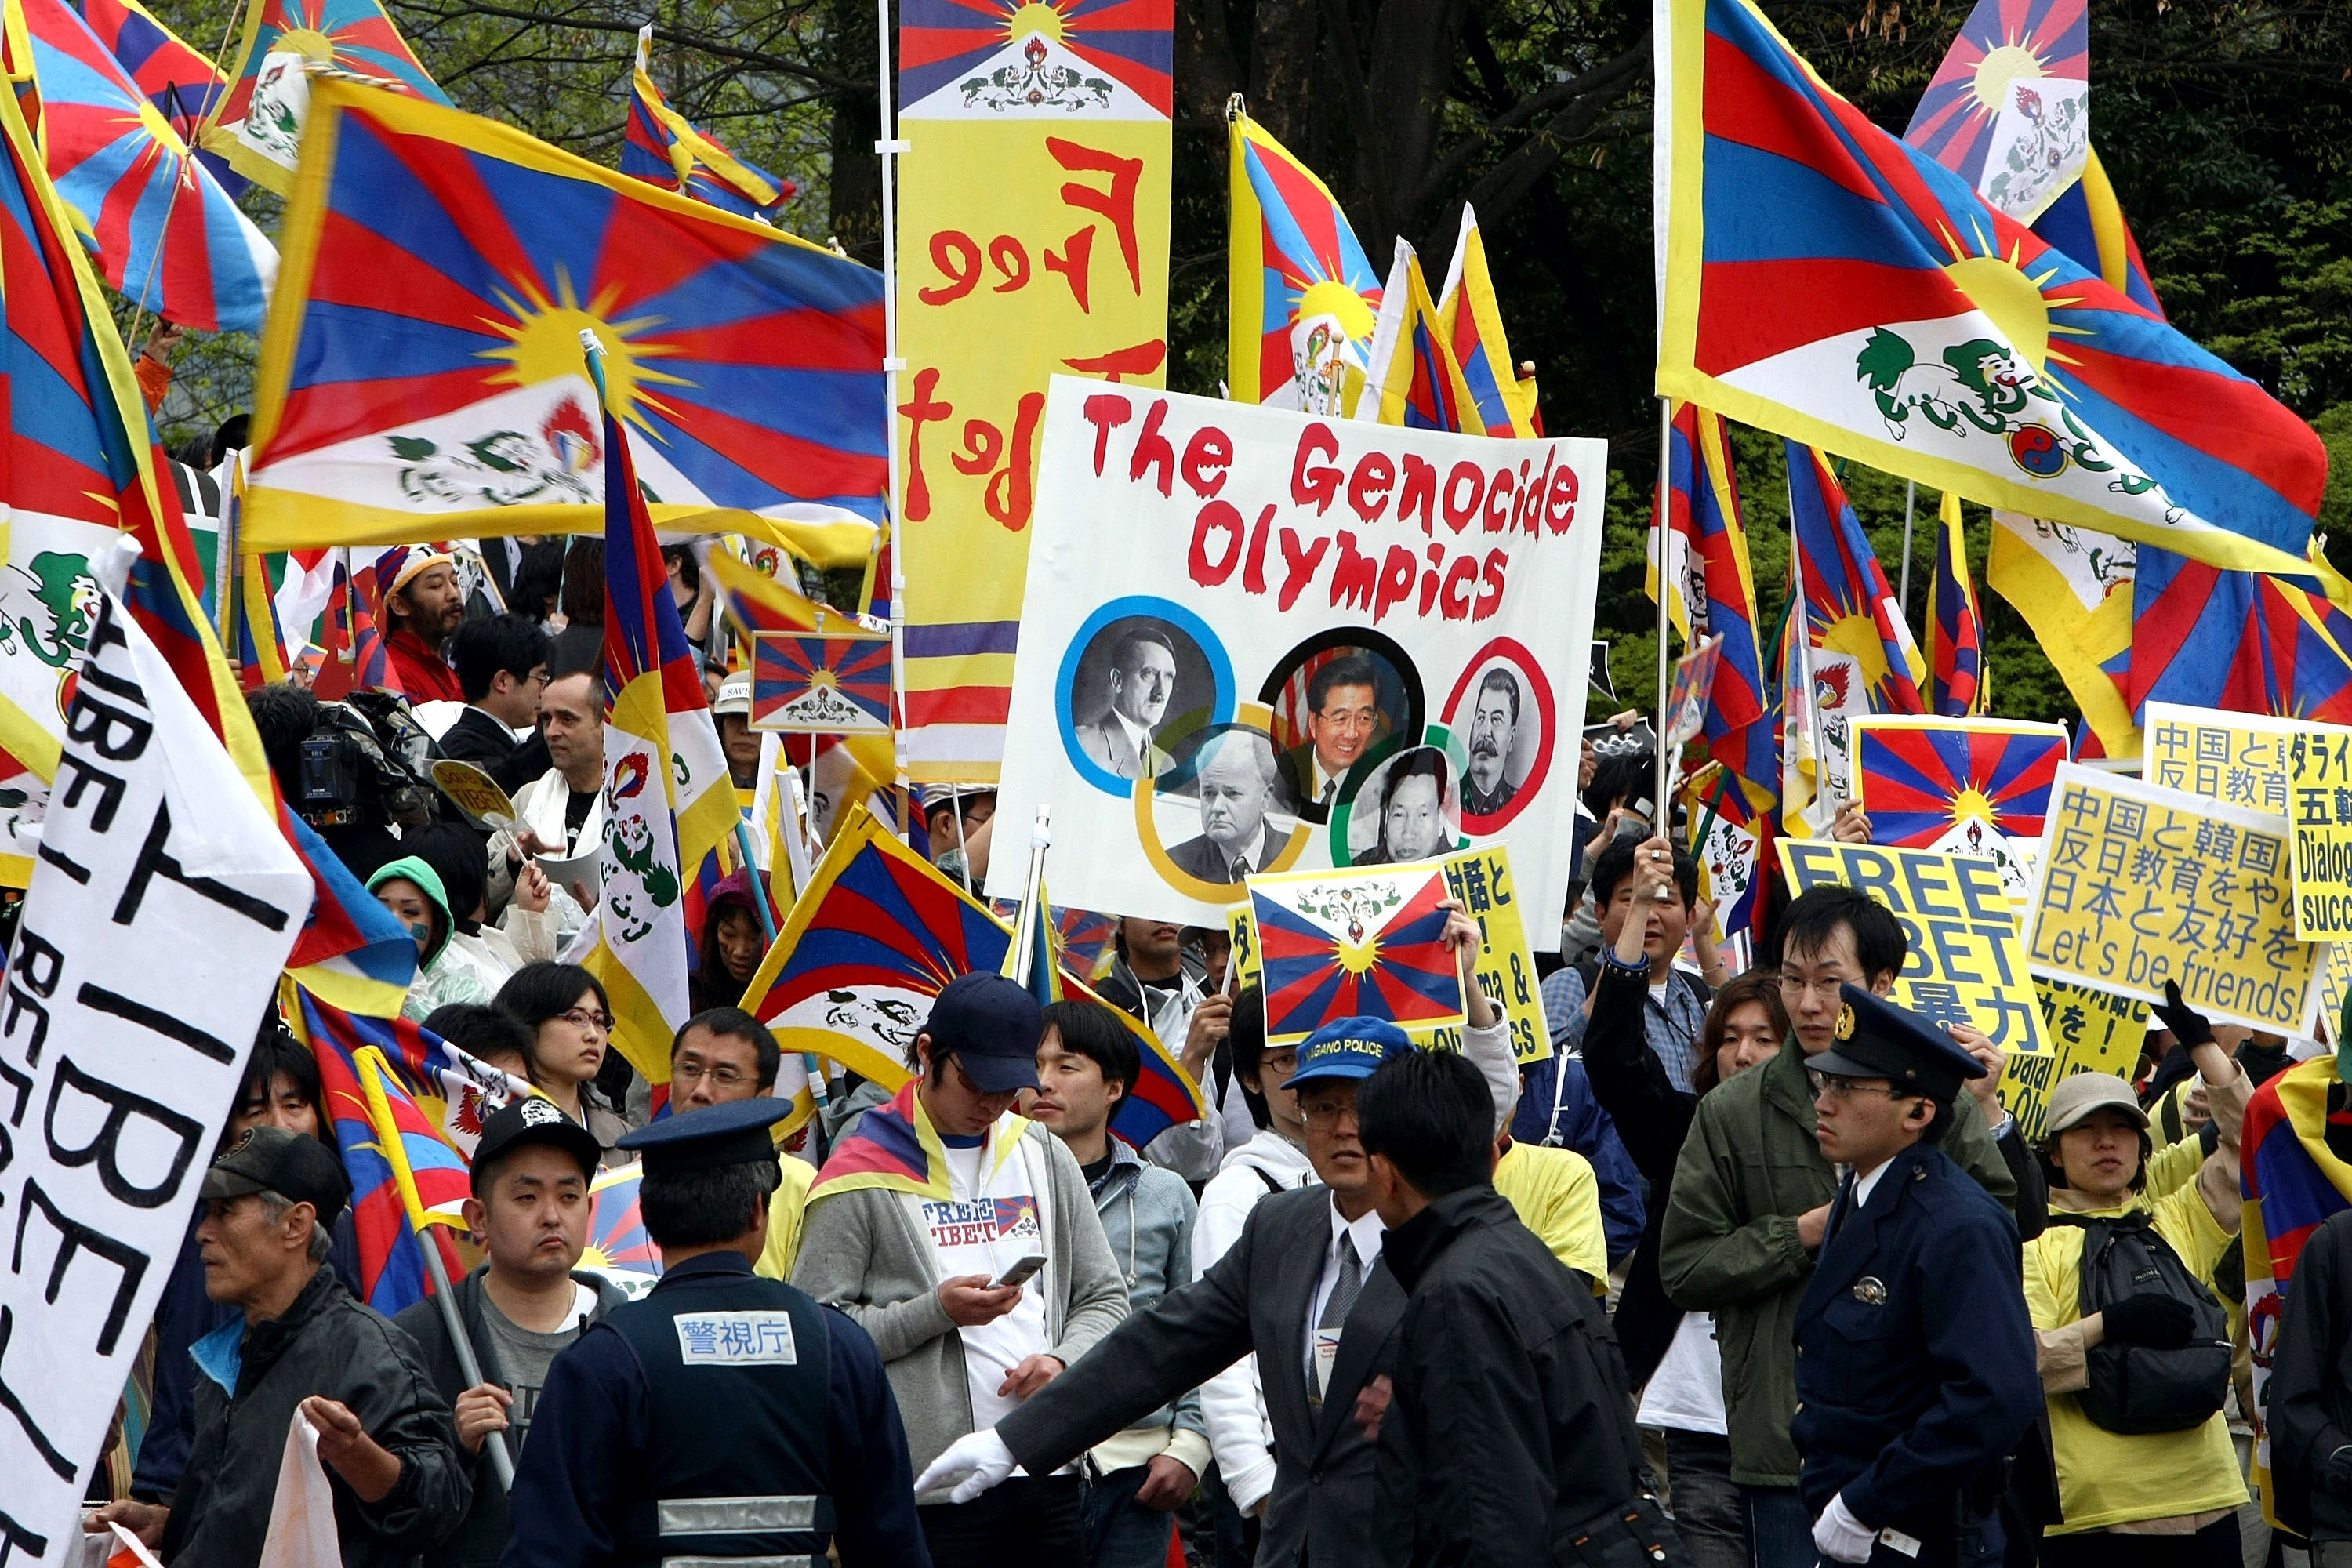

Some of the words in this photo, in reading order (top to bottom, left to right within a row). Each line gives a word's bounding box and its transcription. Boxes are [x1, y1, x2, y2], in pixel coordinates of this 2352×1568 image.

[1083, 394, 1233, 499] The
[1290, 423, 1578, 544] Genocide
[1187, 499, 1509, 625] Olympics
[2290, 733, 2350, 782] ダライ
[1787, 844, 2014, 923] FREE
[1509, 952, 1531, 1006] &
[1896, 917, 2014, 986] BET
[2031, 912, 2119, 977] Let's
[2125, 935, 2171, 989] be
[2180, 949, 2309, 1025] friends!
[1344, 1039, 1384, 1058] POLICE
[1889, 981, 2039, 1052] 暴力
[922, 1198, 995, 1225] FREE
[681, 1320, 788, 1356] 警視庁
